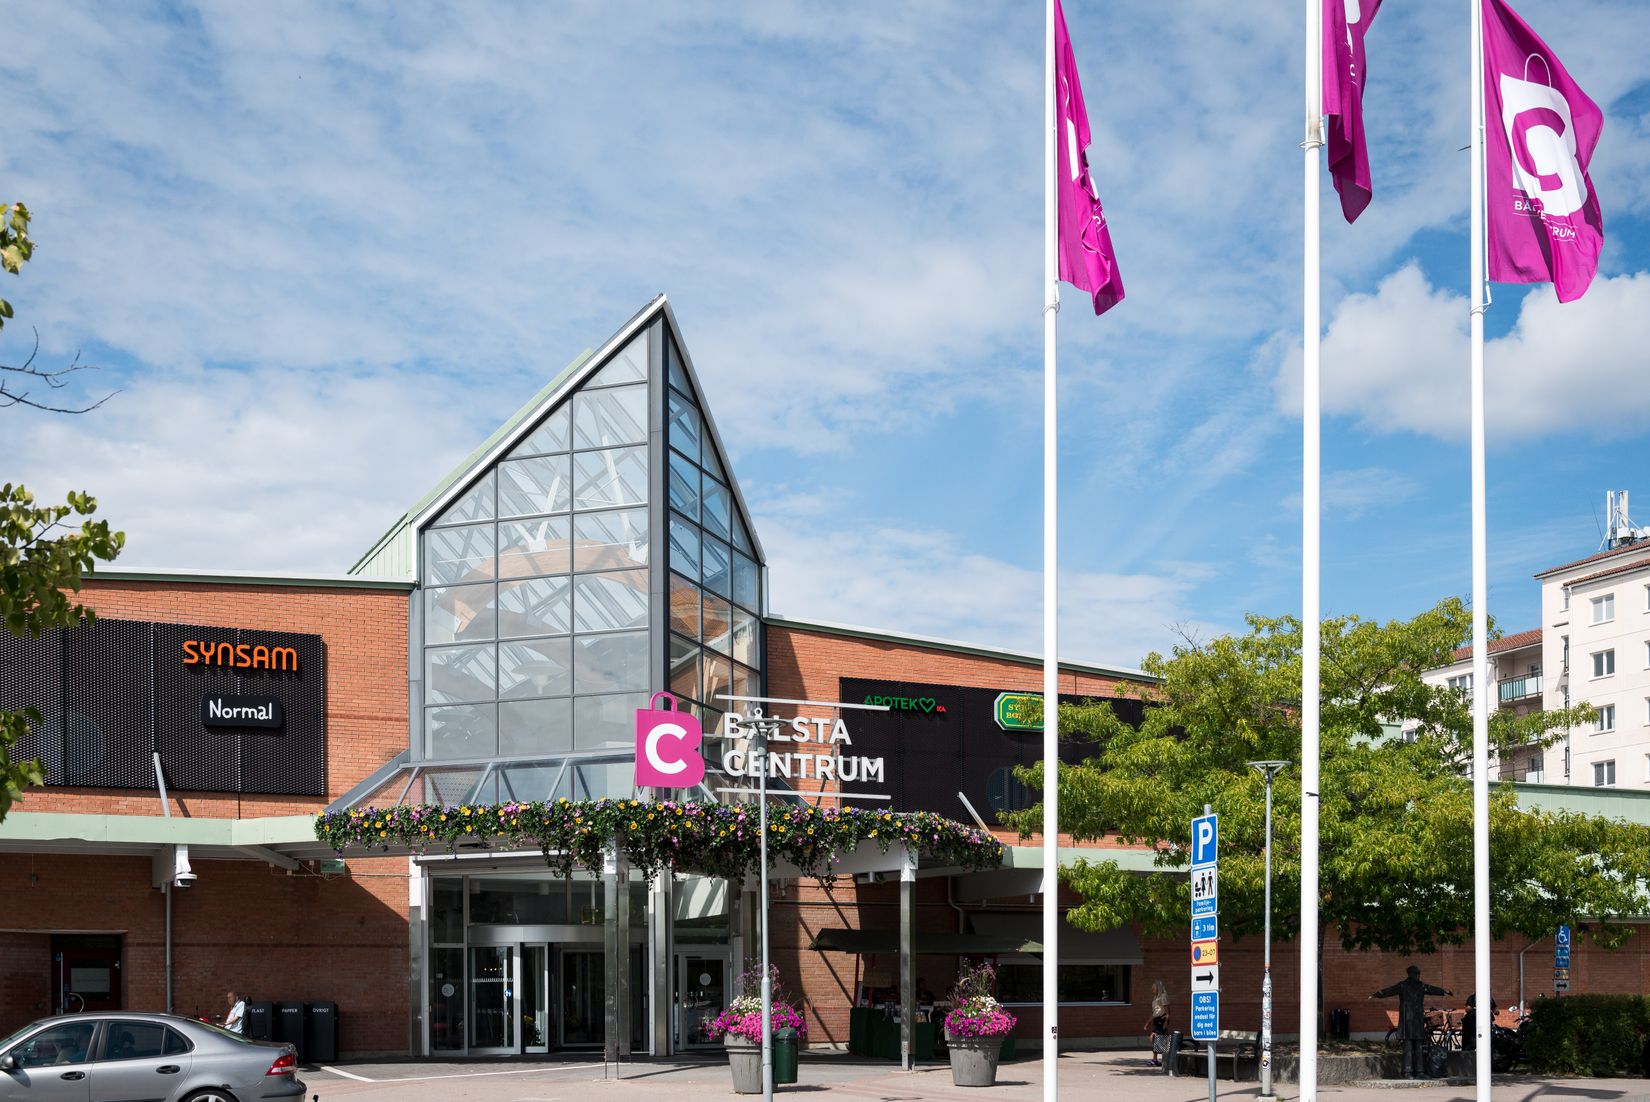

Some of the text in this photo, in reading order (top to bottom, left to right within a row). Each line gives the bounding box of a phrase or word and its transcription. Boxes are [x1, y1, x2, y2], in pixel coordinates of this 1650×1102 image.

[182, 640, 298, 671] SYNSAM
[209, 698, 273, 720] Normal
[865, 695, 919, 710] APOTEK
[645, 723, 688, 774] C
[723, 750, 885, 783] CENTRUM
[1197, 821, 1213, 861] P
